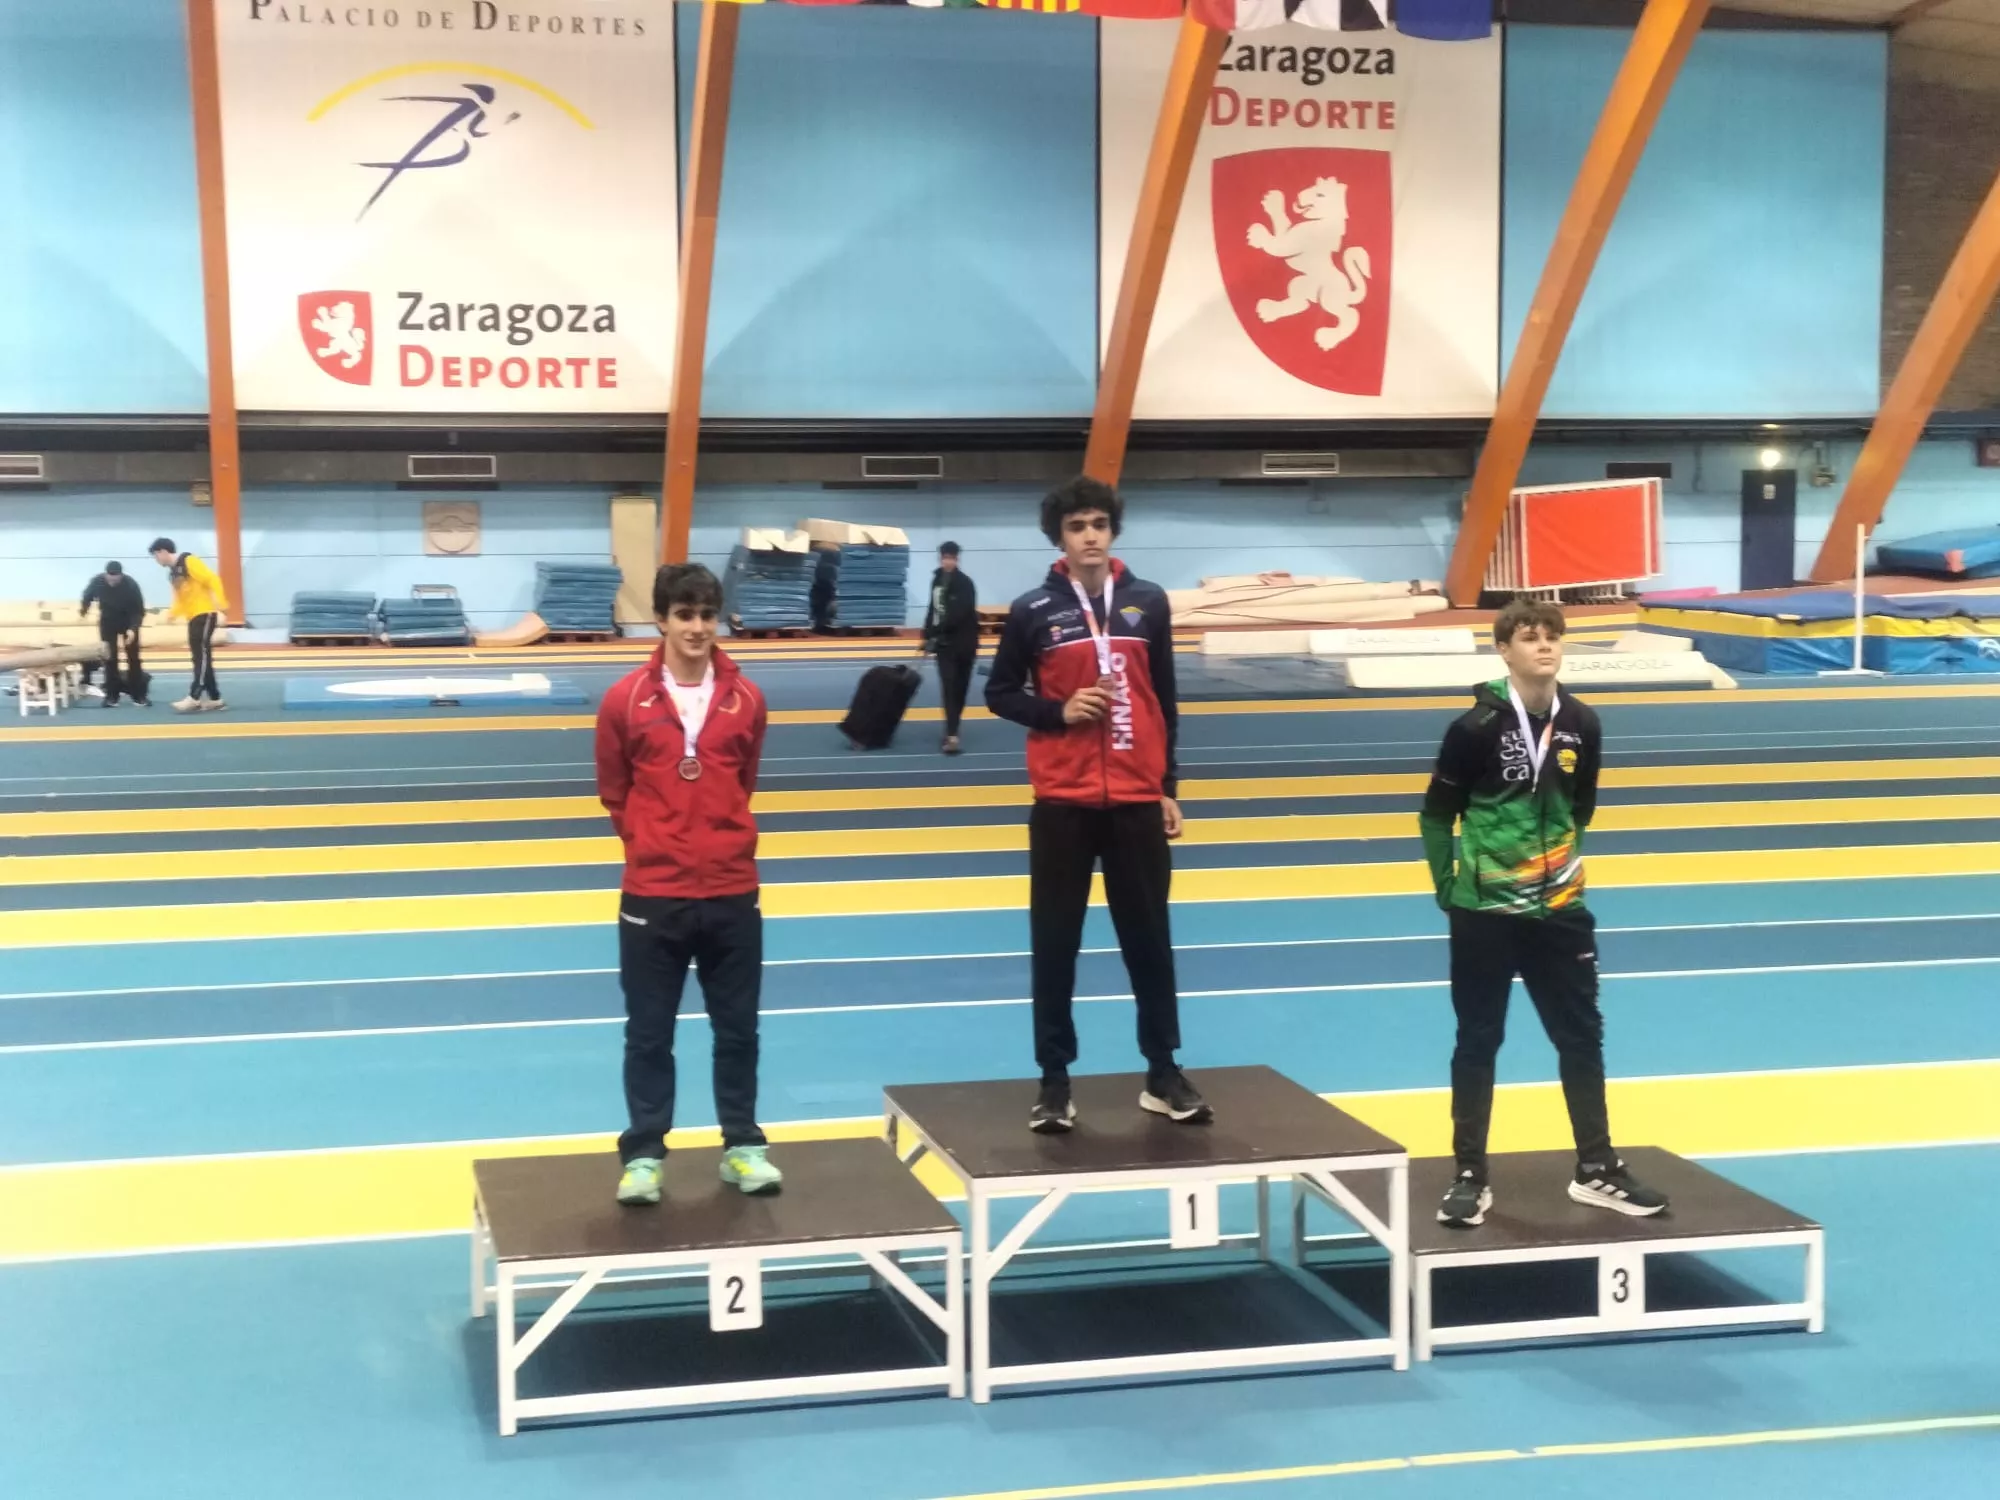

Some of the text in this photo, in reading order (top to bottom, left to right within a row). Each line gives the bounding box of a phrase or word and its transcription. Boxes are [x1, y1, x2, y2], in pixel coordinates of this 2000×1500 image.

[416, 10, 454, 29] DE
[472, 0, 646, 36] DEPORTES
[1210, 86, 1395, 130] DEPORTE
[397, 291, 616, 345] Zaragoza
[398, 344, 617, 388] DEPORTE
[1188, 1194, 1195, 1230] 1
[726, 1276, 745, 1314] 2
[1613, 1268, 1629, 1303] 3
